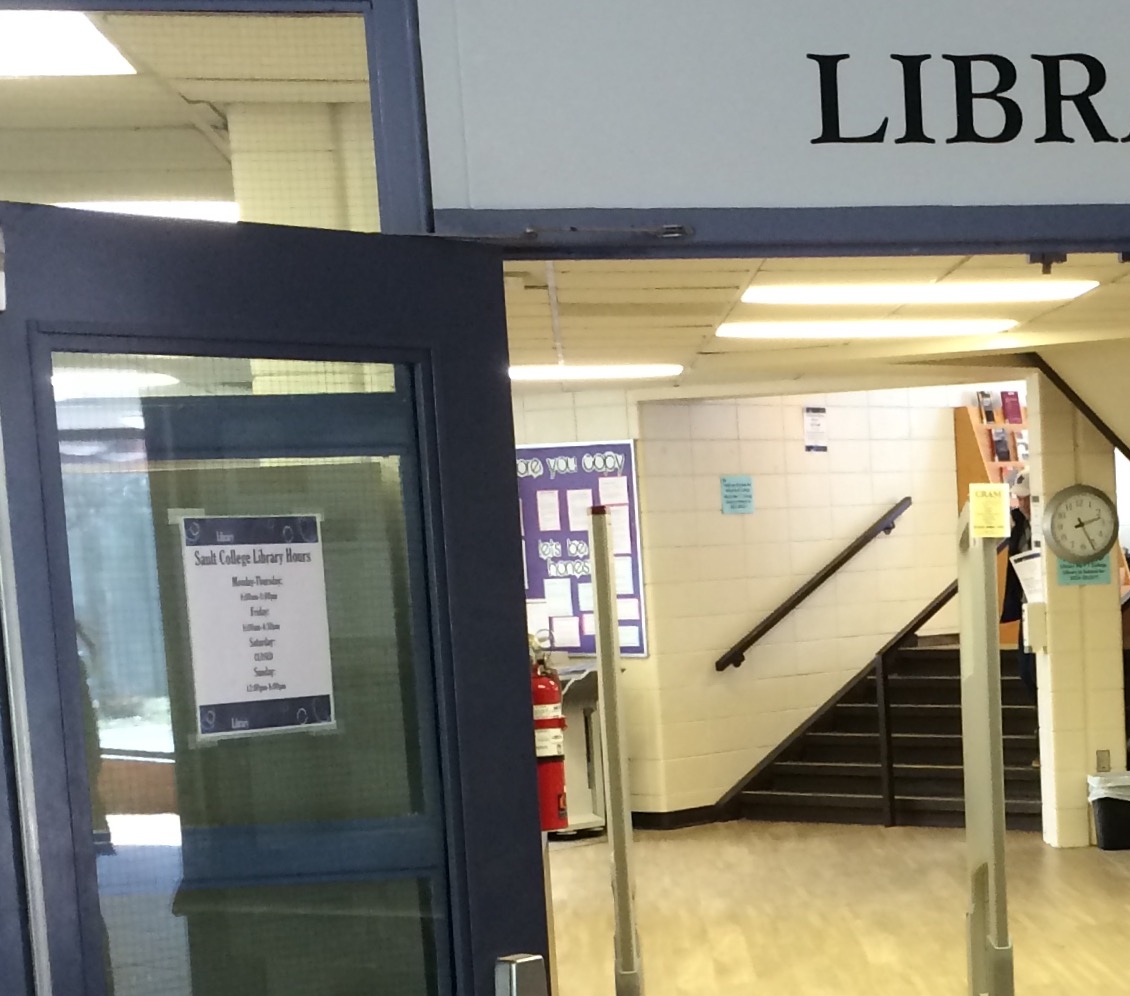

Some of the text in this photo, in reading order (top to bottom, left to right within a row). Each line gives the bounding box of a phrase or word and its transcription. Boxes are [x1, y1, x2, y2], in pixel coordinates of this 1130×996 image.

[546, 456, 577, 479] you
[194, 547, 312, 567] Sault College Library Hours
[547, 559, 591, 578] hones
